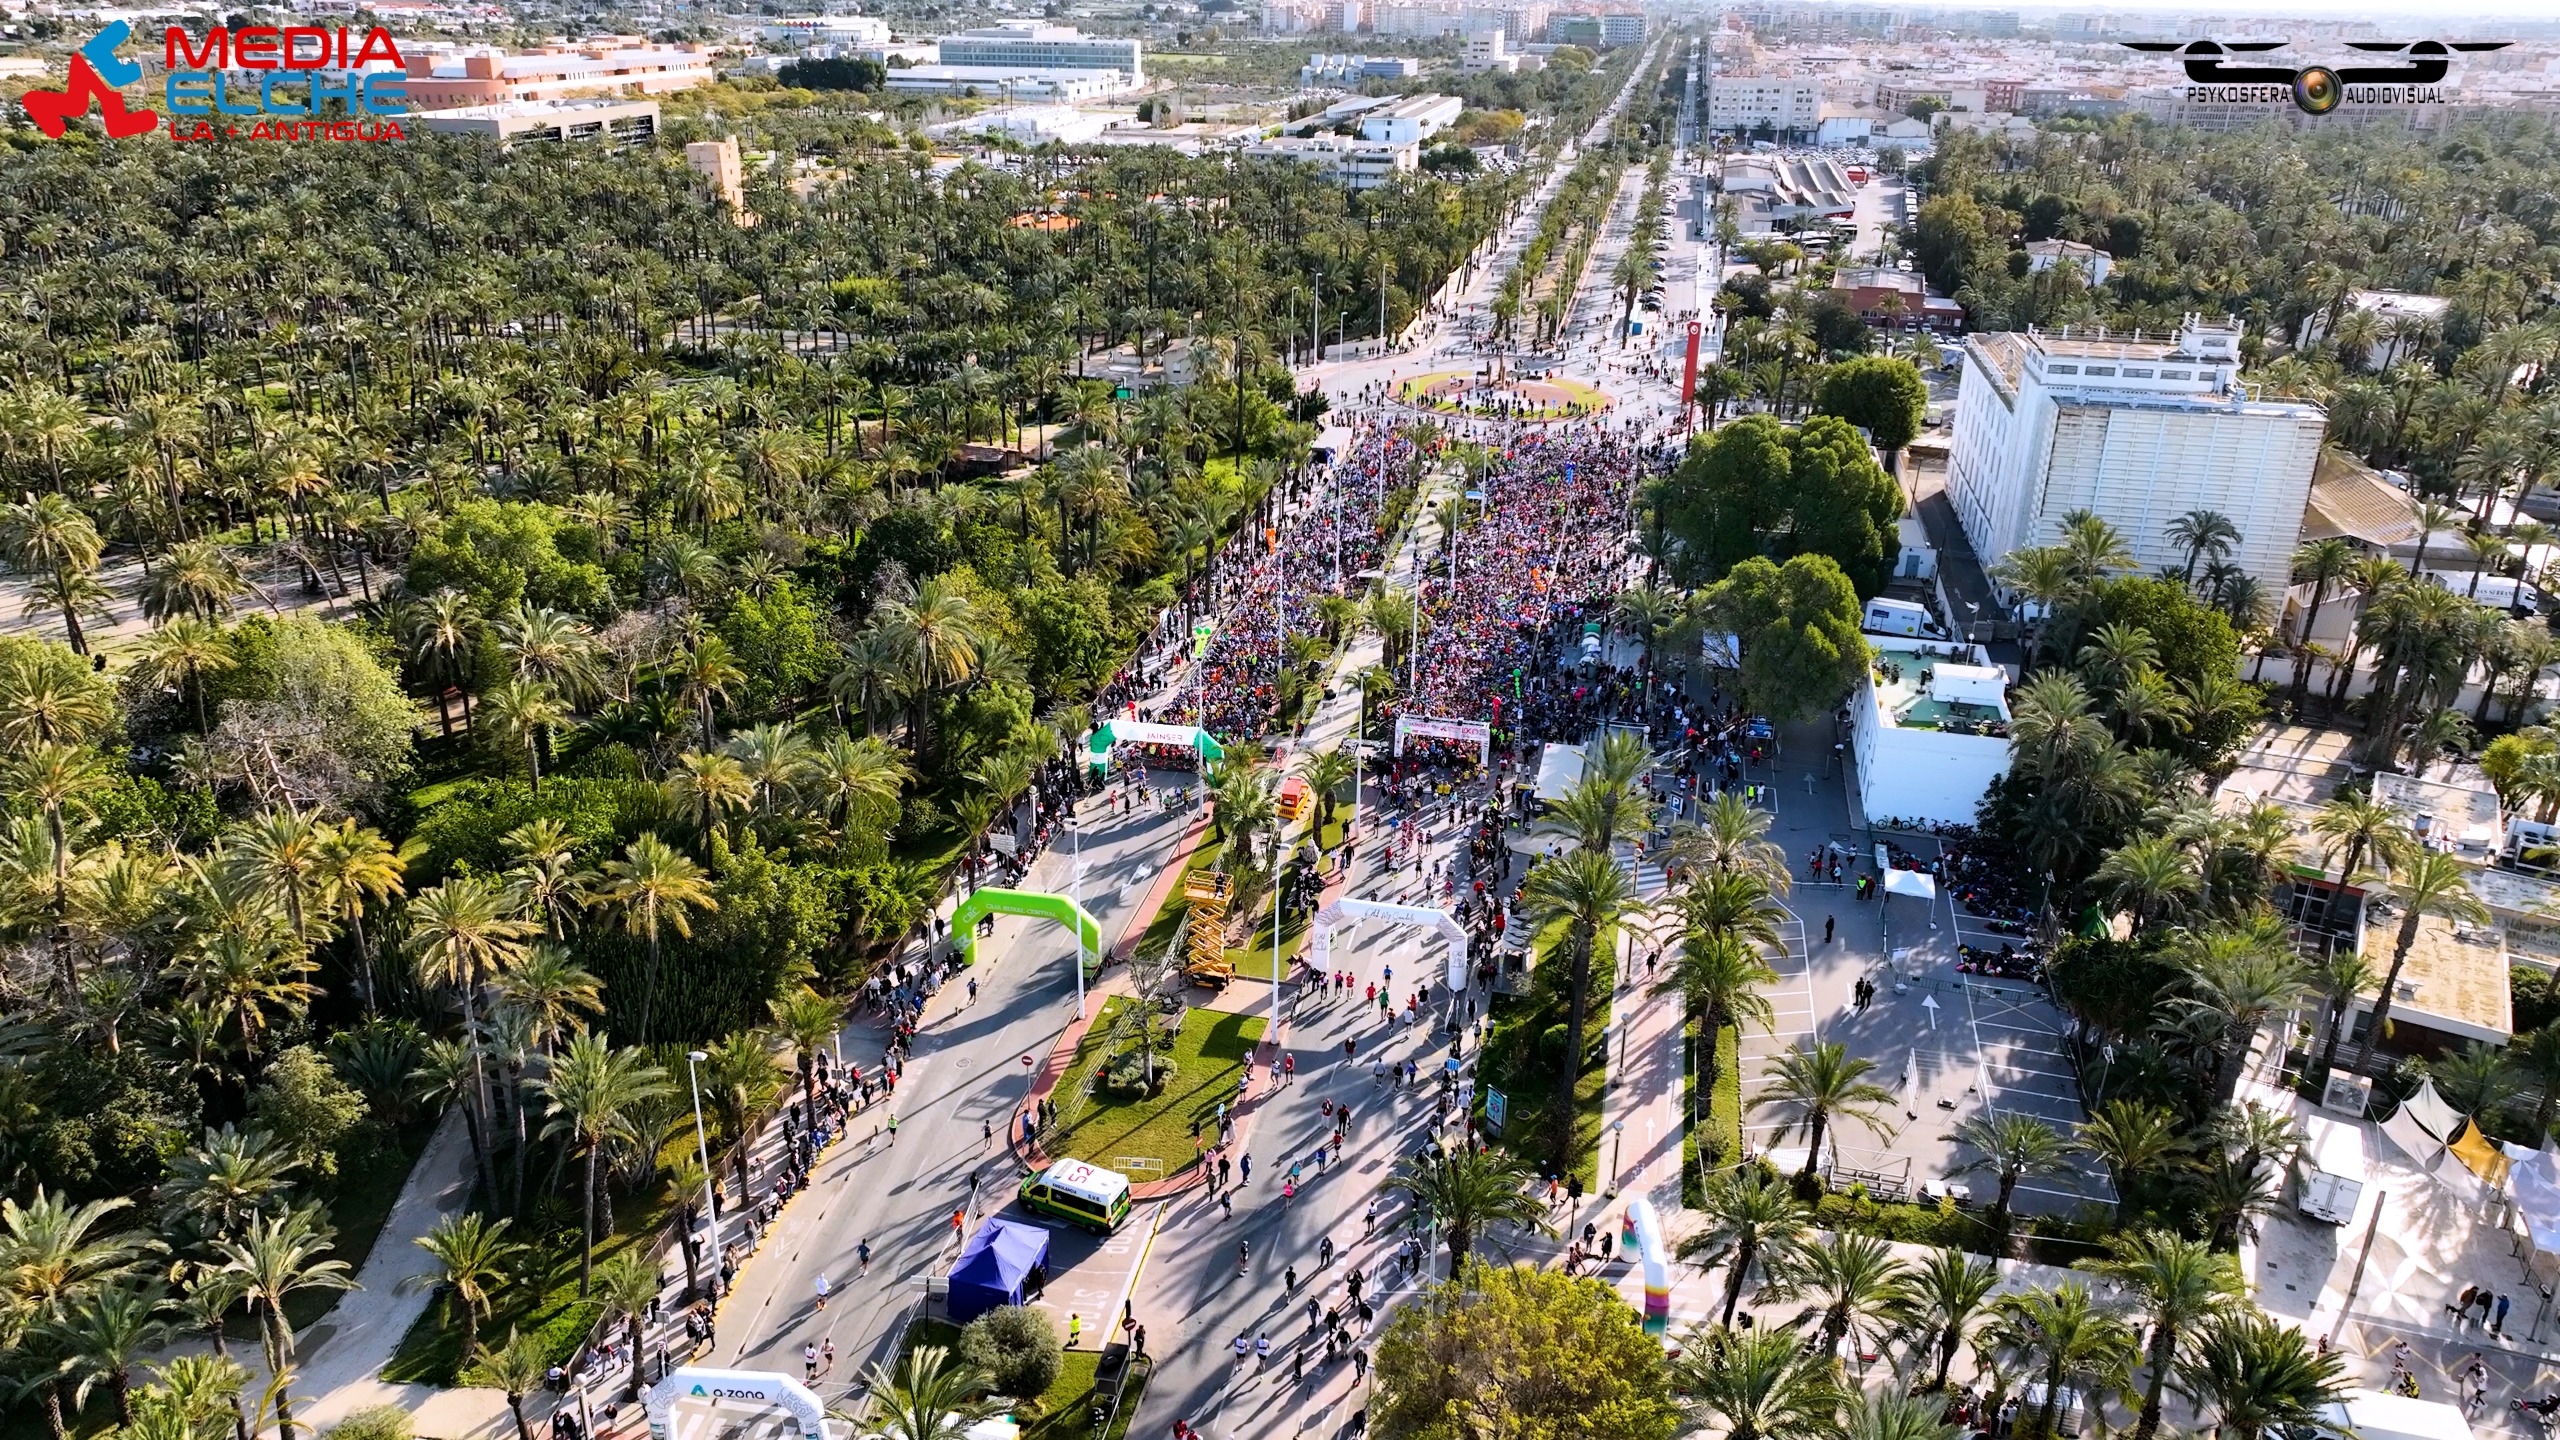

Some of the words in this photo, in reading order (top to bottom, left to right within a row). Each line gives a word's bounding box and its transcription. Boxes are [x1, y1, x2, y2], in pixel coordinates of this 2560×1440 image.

[1146, 732, 1183, 742] JAINSER
[1673, 797, 1679, 806] P
[962, 906, 981, 924] CRC
[1002, 905, 1025, 913] RURAL
[1026, 908, 1057, 917] CENTRAL
[1068, 1166, 1095, 1184] 52
[1052, 1182, 1077, 1195] AMBULANCIA
[1061, 1288, 1111, 1332] STOP
